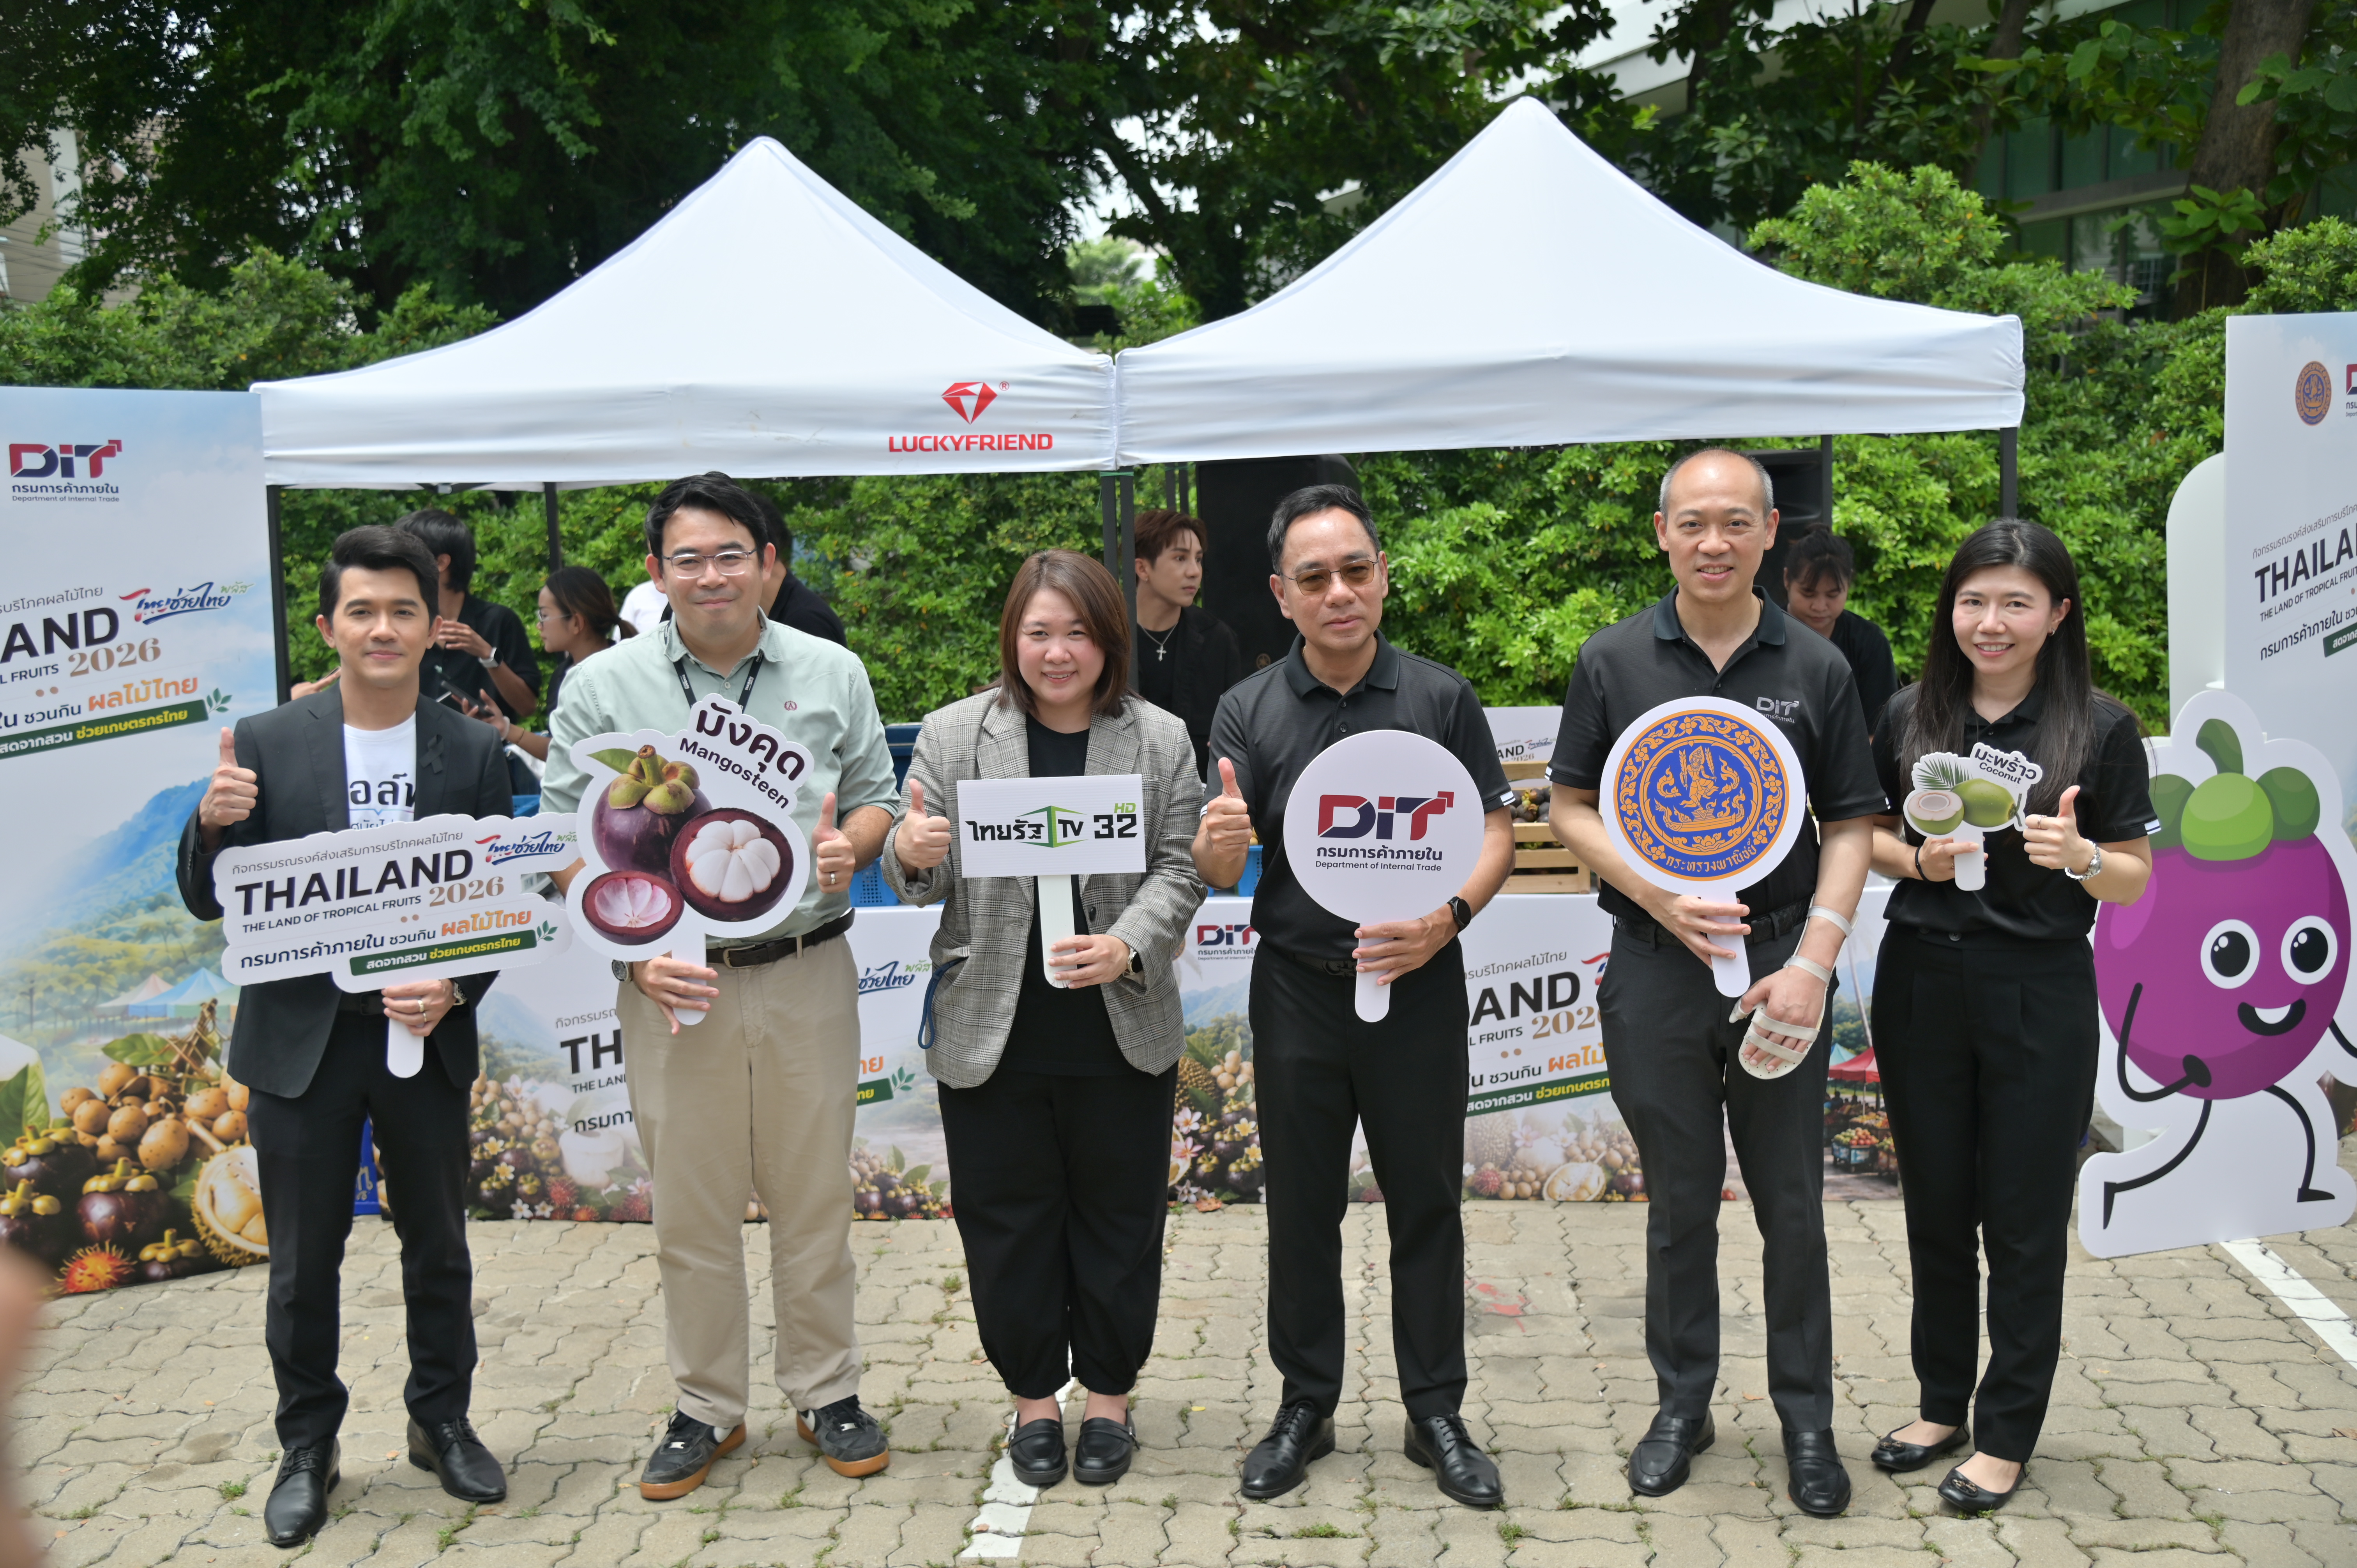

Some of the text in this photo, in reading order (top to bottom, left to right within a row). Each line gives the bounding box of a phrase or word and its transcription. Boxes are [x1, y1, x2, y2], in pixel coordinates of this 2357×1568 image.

[889, 434, 1053, 452] LUCKYFRIEND
[12, 482, 119, 494] กรมการค้าภายใน
[2255, 523, 2357, 603] THAILA
[2260, 608, 2273, 622] THE
[2274, 598, 2293, 615] LAND
[2295, 592, 2304, 604] OF
[2305, 576, 2338, 599] TROPICAL
[2261, 606, 2357, 660] กรมการค้าภายใน ชว
[11, 664, 59, 682] FRUITS
[68, 638, 161, 677] 2026
[25, 704, 81, 724] ชวนกิน
[88, 677, 198, 711] ผลไม้ไทย
[0, 709, 188, 754] สดจากสวน ช่วยเกษตรกรไทย
[696, 703, 805, 781] มังคุด
[680, 738, 789, 809] Mangosteen
[1975, 749, 2037, 780] มะพร้าว
[1979, 762, 2021, 784] Coconut
[1114, 803, 1136, 813] HD
[965, 814, 1138, 841] ไทยรัฐ TV 32
[233, 832, 463, 874] กิจกรรมรณรงค์ส่งเสริมการบริโภคผลไม้ไทย
[1315, 861, 1368, 869] Department
[1317, 845, 1442, 860] กรมการค้าภายใน
[1666, 838, 1757, 872] กระทรวงพาณิชย์
[235, 849, 474, 916] THAILAND
[243, 876, 504, 933] THE LAND OF TROPICAL FRUITS 2026
[241, 910, 532, 968] กรมการค้าภายใน ชวนกิน ผลไม้ไทย
[366, 938, 521, 969] สดจากสวน ช่วยเกษตรกรไทย
[1480, 1027, 1523, 1044] FRUITS
[1532, 1006, 1601, 1039] 202
[572, 1074, 626, 1094] THE LAN
[1490, 1065, 1542, 1084] ชวนกิน
[1467, 1092, 1532, 1112] สดจากสวน
